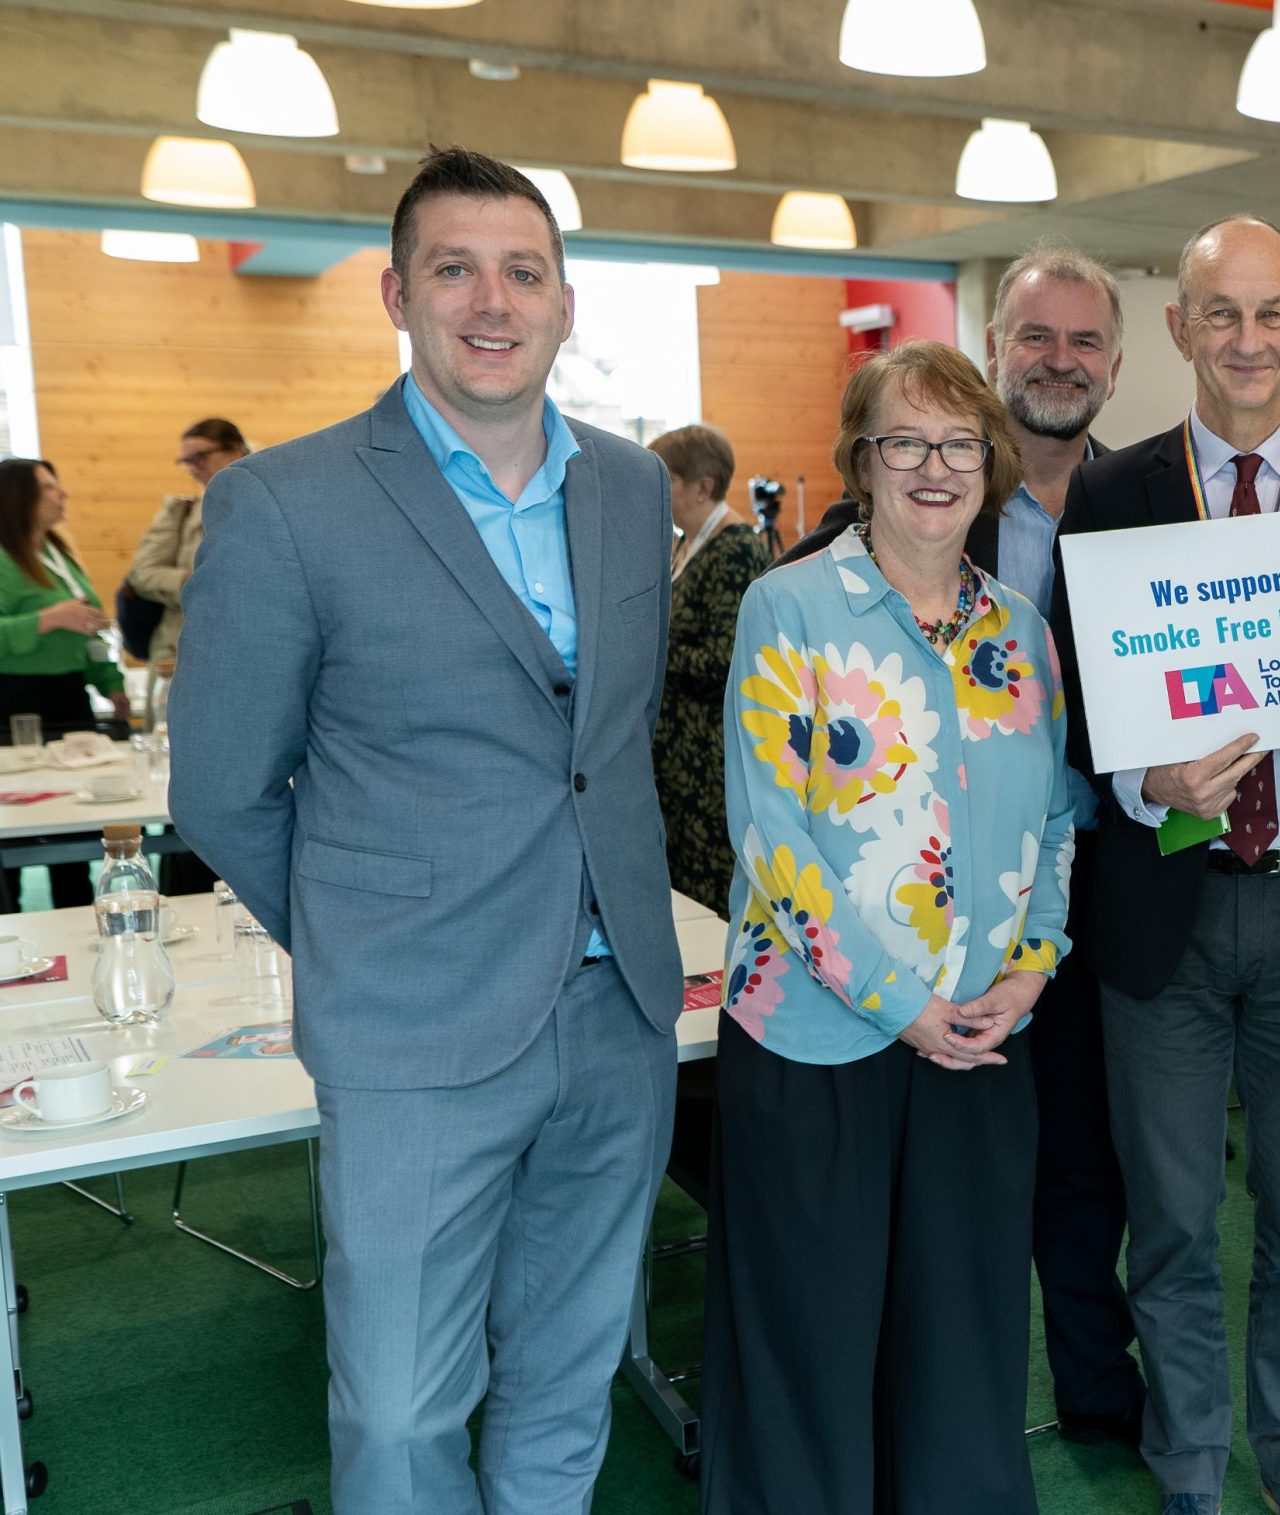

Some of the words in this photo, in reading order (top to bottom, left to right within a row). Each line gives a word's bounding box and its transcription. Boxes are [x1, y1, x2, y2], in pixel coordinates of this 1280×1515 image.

[1150, 578, 1189, 607] We
[1112, 624, 1200, 657] Smoke
[1215, 617, 1271, 644] Free
[1164, 663, 1260, 720] LTA
